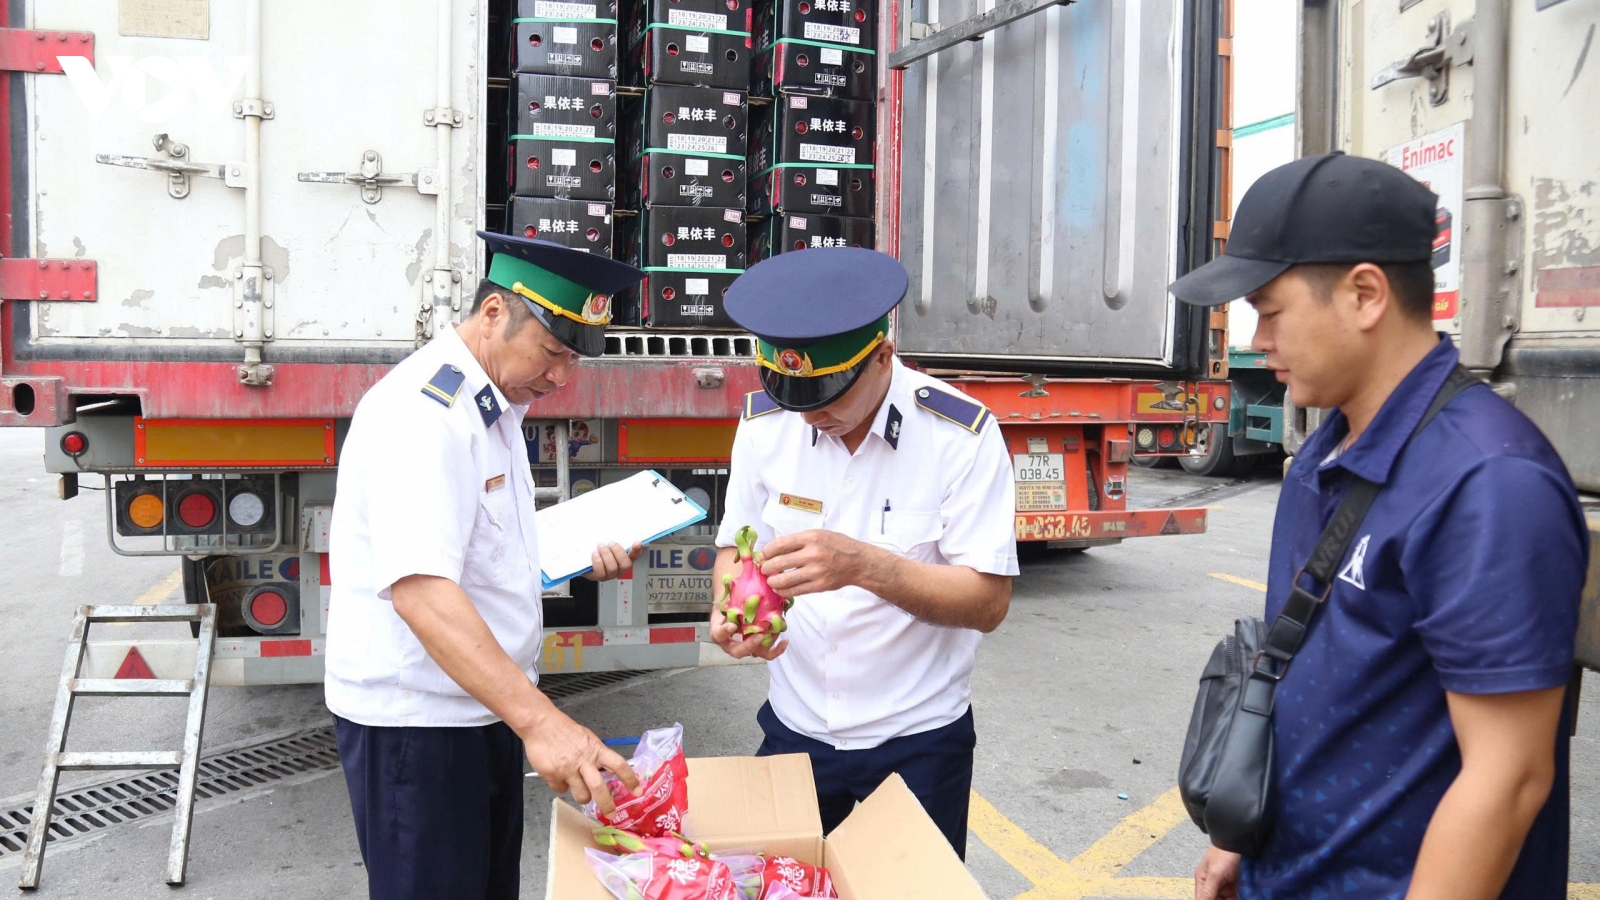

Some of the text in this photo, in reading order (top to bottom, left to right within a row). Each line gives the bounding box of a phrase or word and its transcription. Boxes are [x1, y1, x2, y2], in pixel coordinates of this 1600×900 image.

[544, 96, 585, 111] 果依丰
[678, 107, 717, 122] 果依丰
[810, 118, 847, 133] 果依丰
[538, 219, 579, 234] 果依丰
[677, 227, 716, 241] 果依丰
[811, 235, 847, 248] 果依丰
[1028, 456, 1050, 467] 77R
[1020, 468, 1059, 480] 038.45
[658, 578, 674, 589] TU
[679, 578, 713, 589] AUTO
